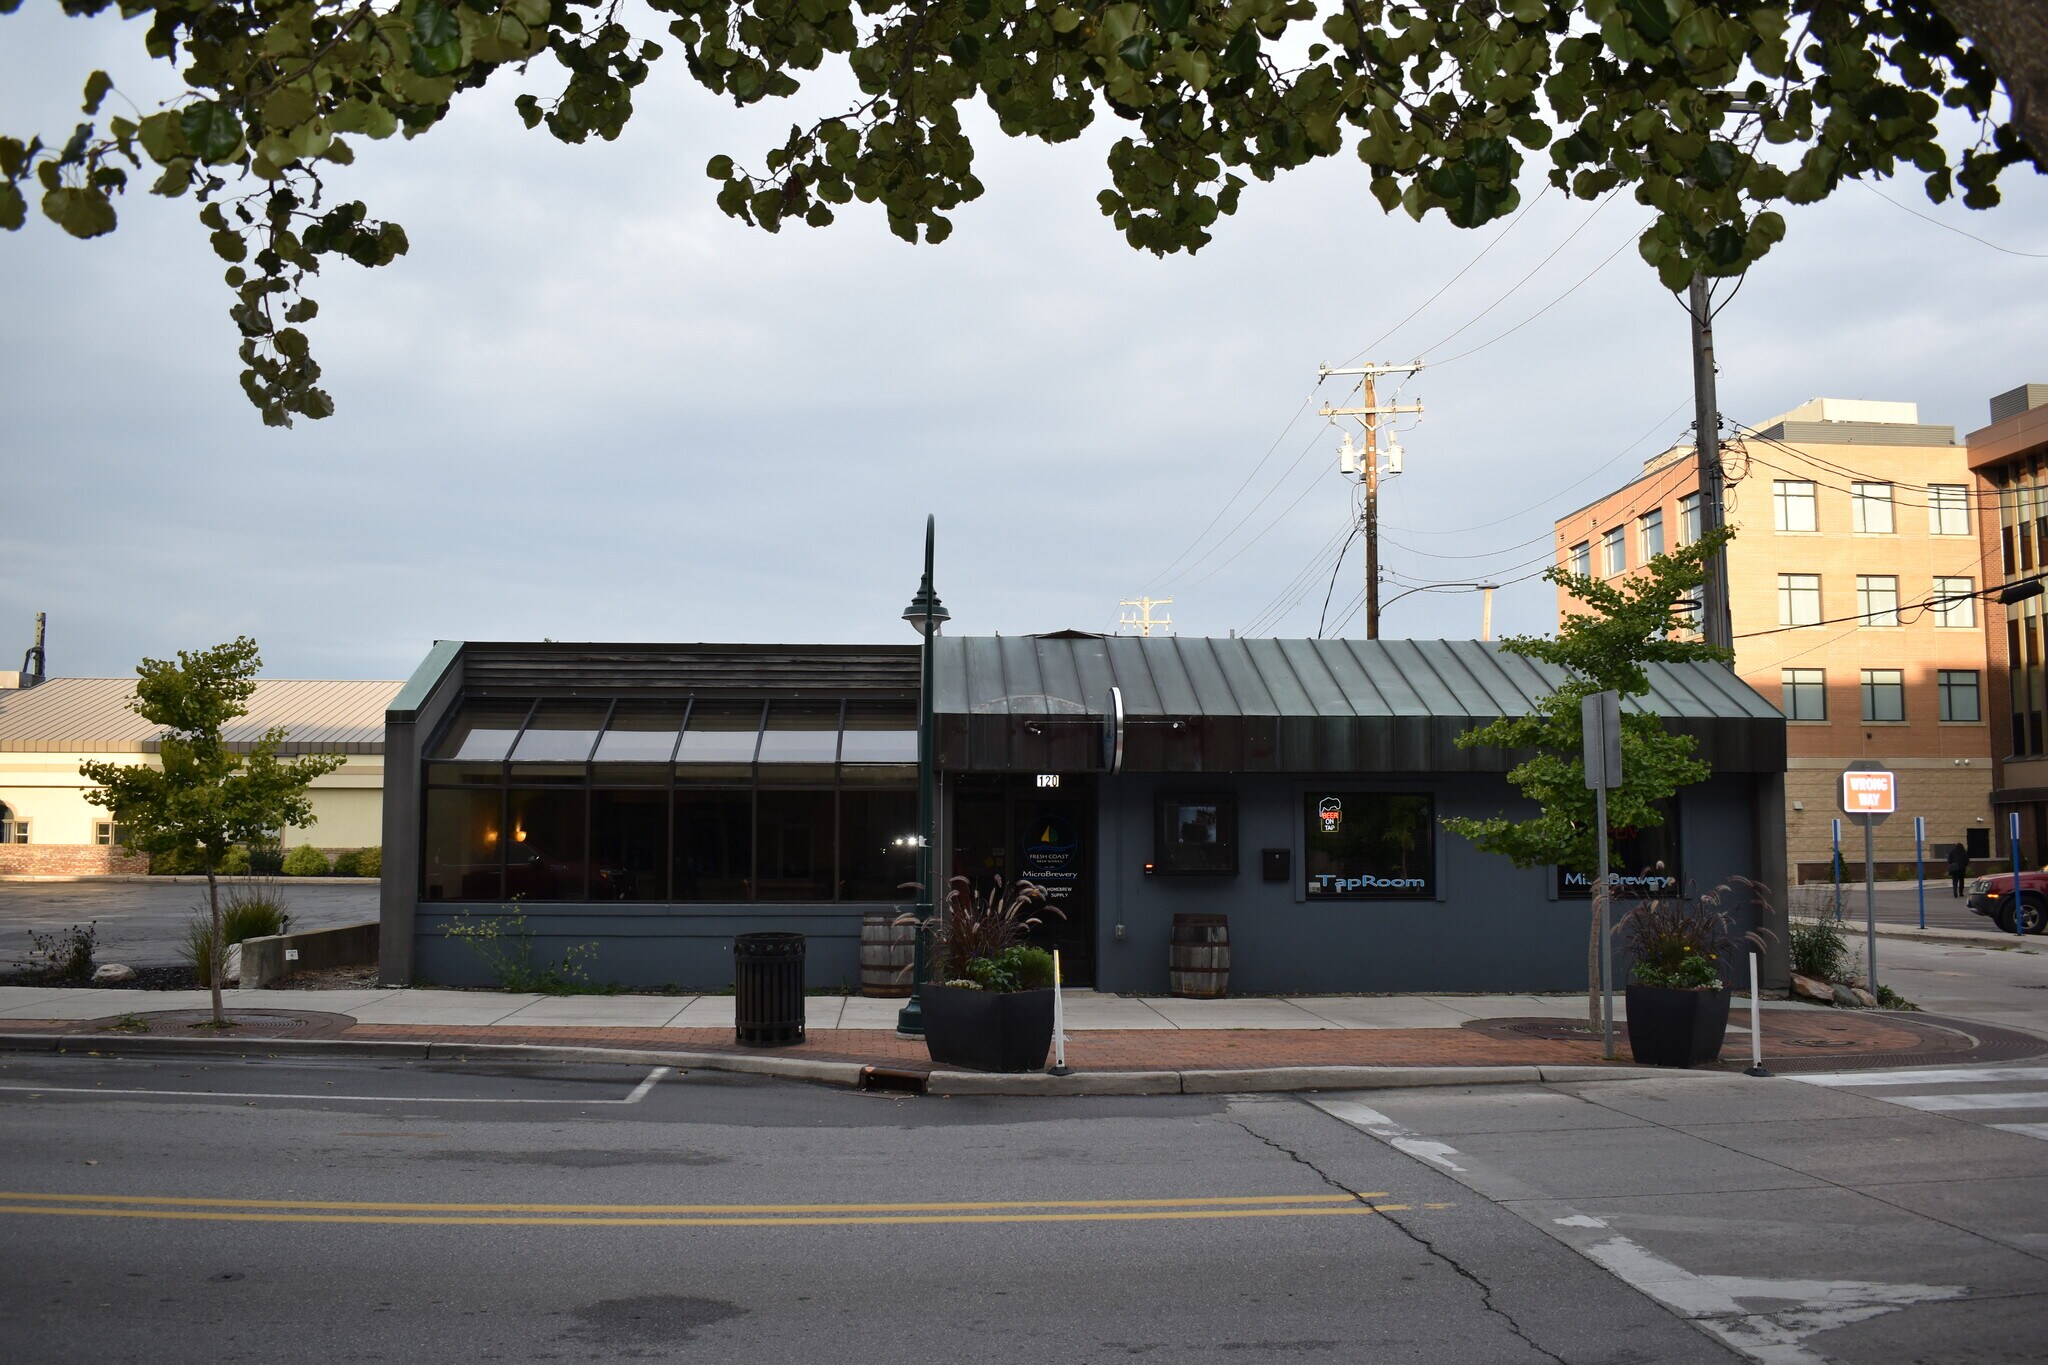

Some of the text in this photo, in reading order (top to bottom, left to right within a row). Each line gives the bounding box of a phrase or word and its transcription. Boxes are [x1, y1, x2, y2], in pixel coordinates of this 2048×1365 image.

[1039, 775, 1058, 787] 120
[1850, 777, 1888, 791] WRONG
[1857, 793, 1880, 806] WAY
[1322, 811, 1339, 819] BEER
[1022, 870, 1078, 879] MicroBrewery
[1565, 872, 1671, 889] MiBrewery
[1315, 874, 1425, 891] TapRoom
